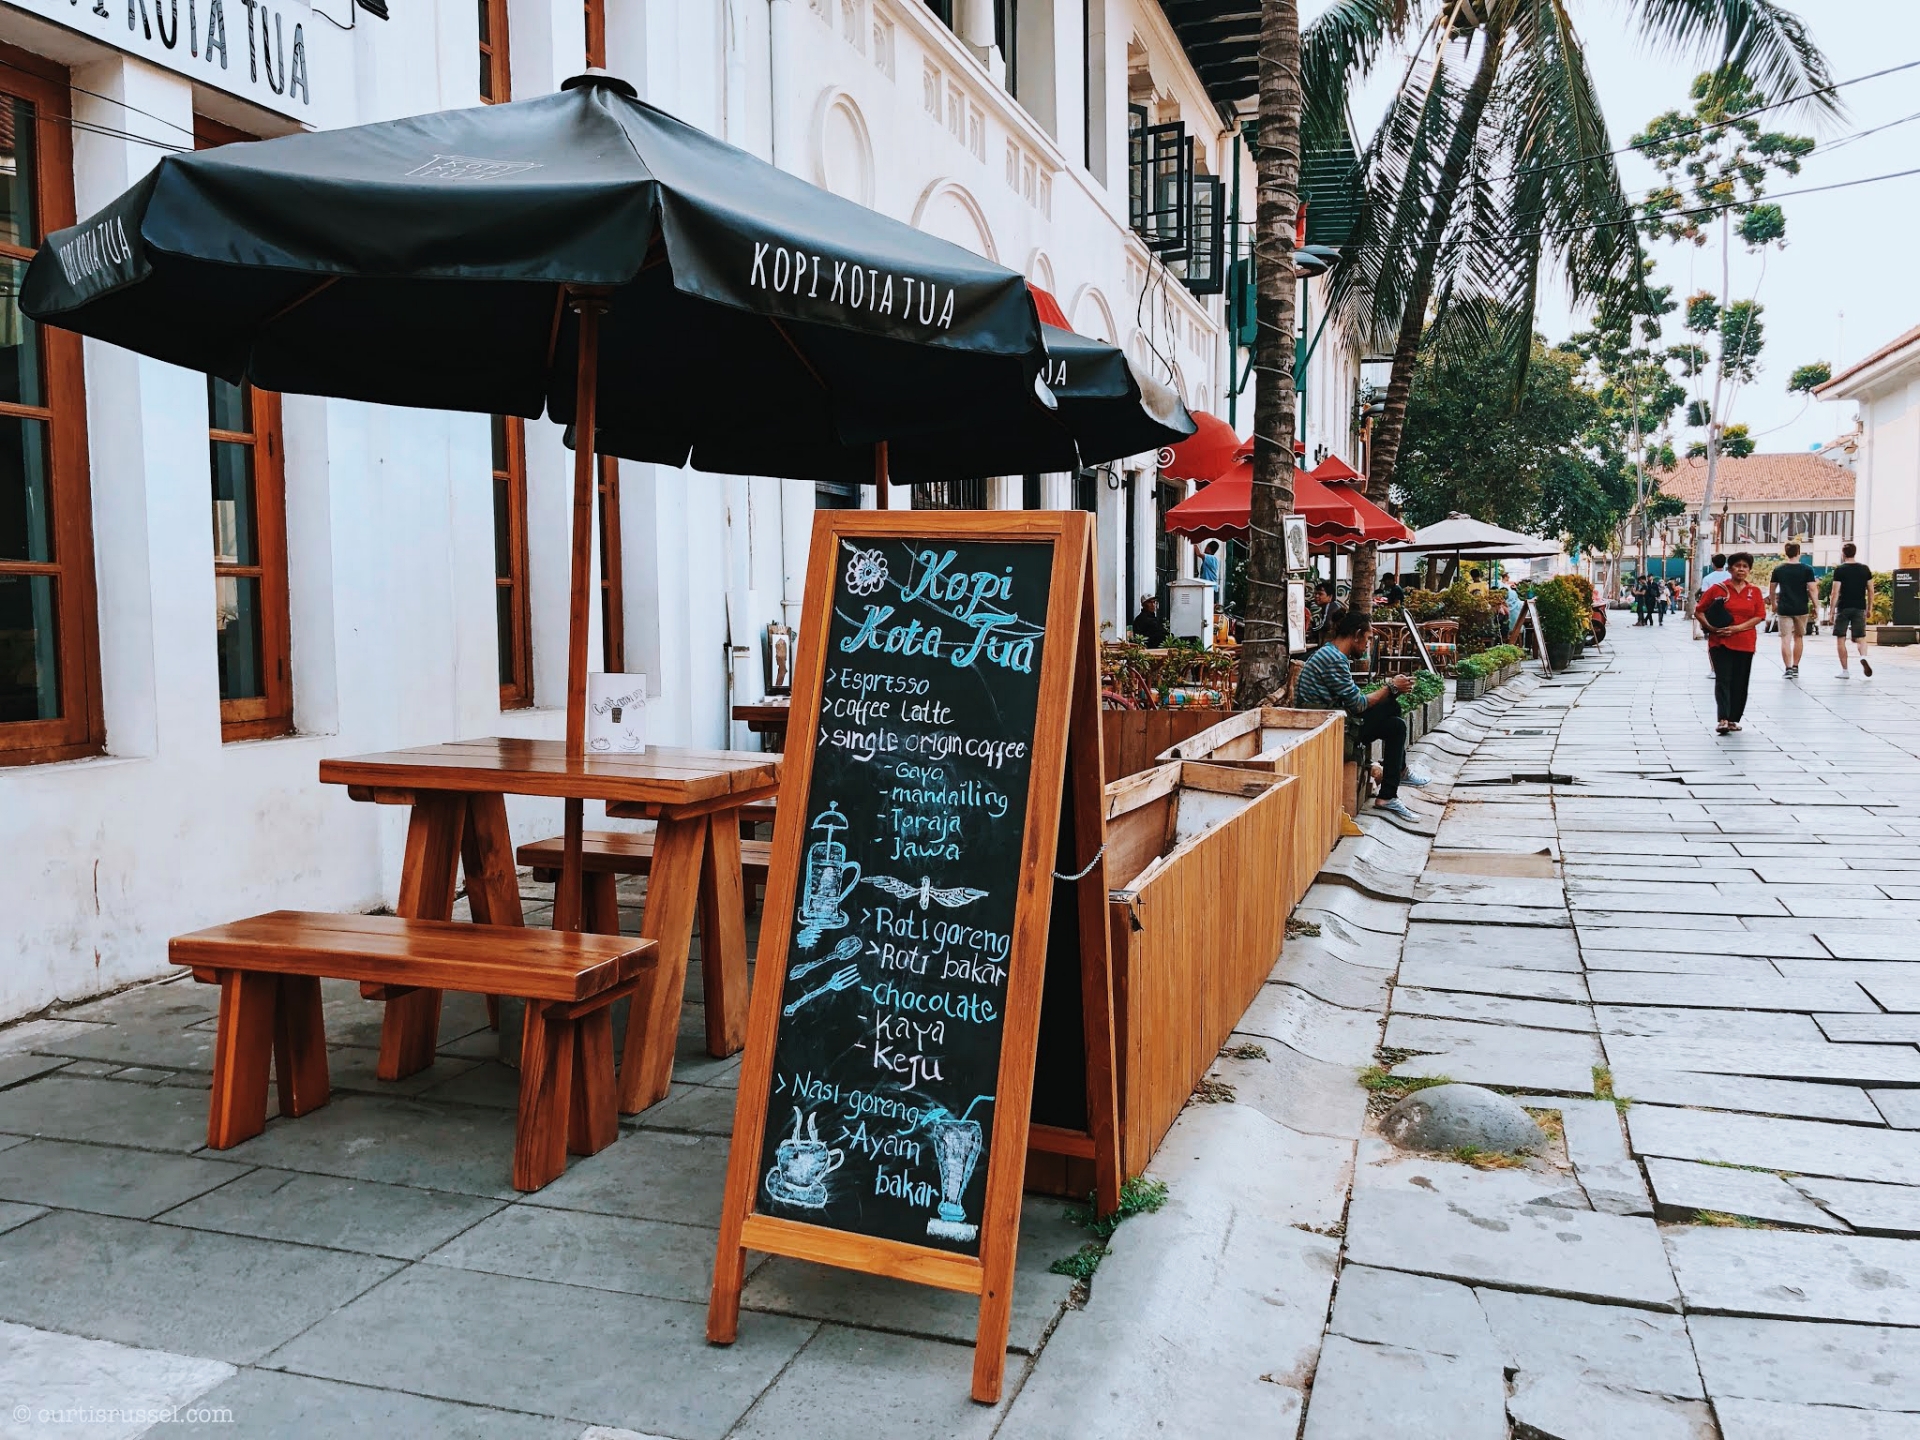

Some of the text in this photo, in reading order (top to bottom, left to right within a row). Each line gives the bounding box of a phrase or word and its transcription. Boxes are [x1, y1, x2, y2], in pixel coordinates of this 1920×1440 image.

[241, 0, 309, 105] TUA
[98, 215, 132, 266] TUA
[751, 242, 954, 329] KOPI KOTA TUA
[901, 550, 1013, 619] Kopi
[840, 605, 1034, 674] Kota Tua
[840, 668, 929, 699] Espresso
[901, 700, 954, 724] Latte
[905, 733, 962, 760] origin
[896, 762, 944, 787] Gayo
[891, 808, 961, 843] Toraja
[890, 837, 960, 861] Jawa
[875, 907, 1010, 962] Roti goreng
[881, 943, 1007, 986] Roti bakar
[877, 1010, 944, 1051] Kaya
[792, 1071, 919, 1135] Nasi goreng
[850, 1121, 920, 1166] Ayam
[875, 1164, 939, 1208] bakar
